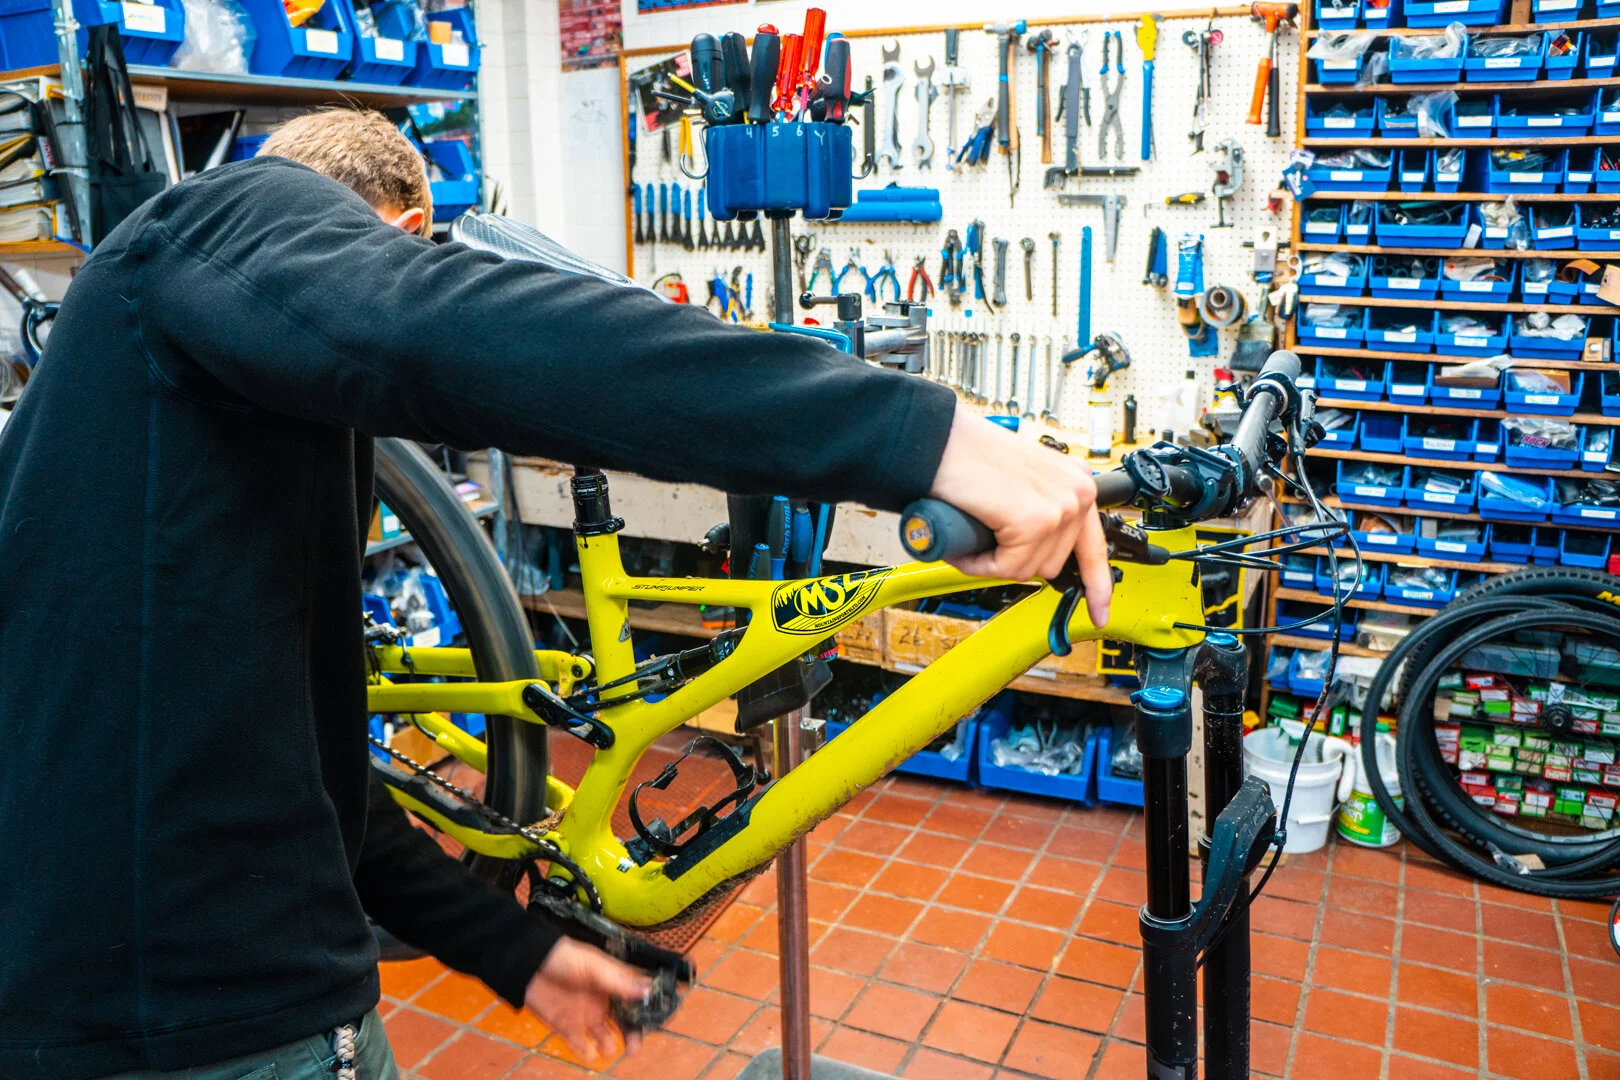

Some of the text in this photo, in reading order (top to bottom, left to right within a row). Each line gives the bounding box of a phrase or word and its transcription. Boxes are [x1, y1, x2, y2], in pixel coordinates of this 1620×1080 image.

[746, 127, 753, 138] 4
[772, 126, 780, 137] 5
[796, 125, 804, 137] 6
[1522, 434, 1549, 448] ROCK
[782, 505, 791, 555] Park Tool
[1121, 525, 1143, 541] SLX
[632, 584, 706, 592] STUMPJUMPER
[800, 573, 864, 615] MSL
